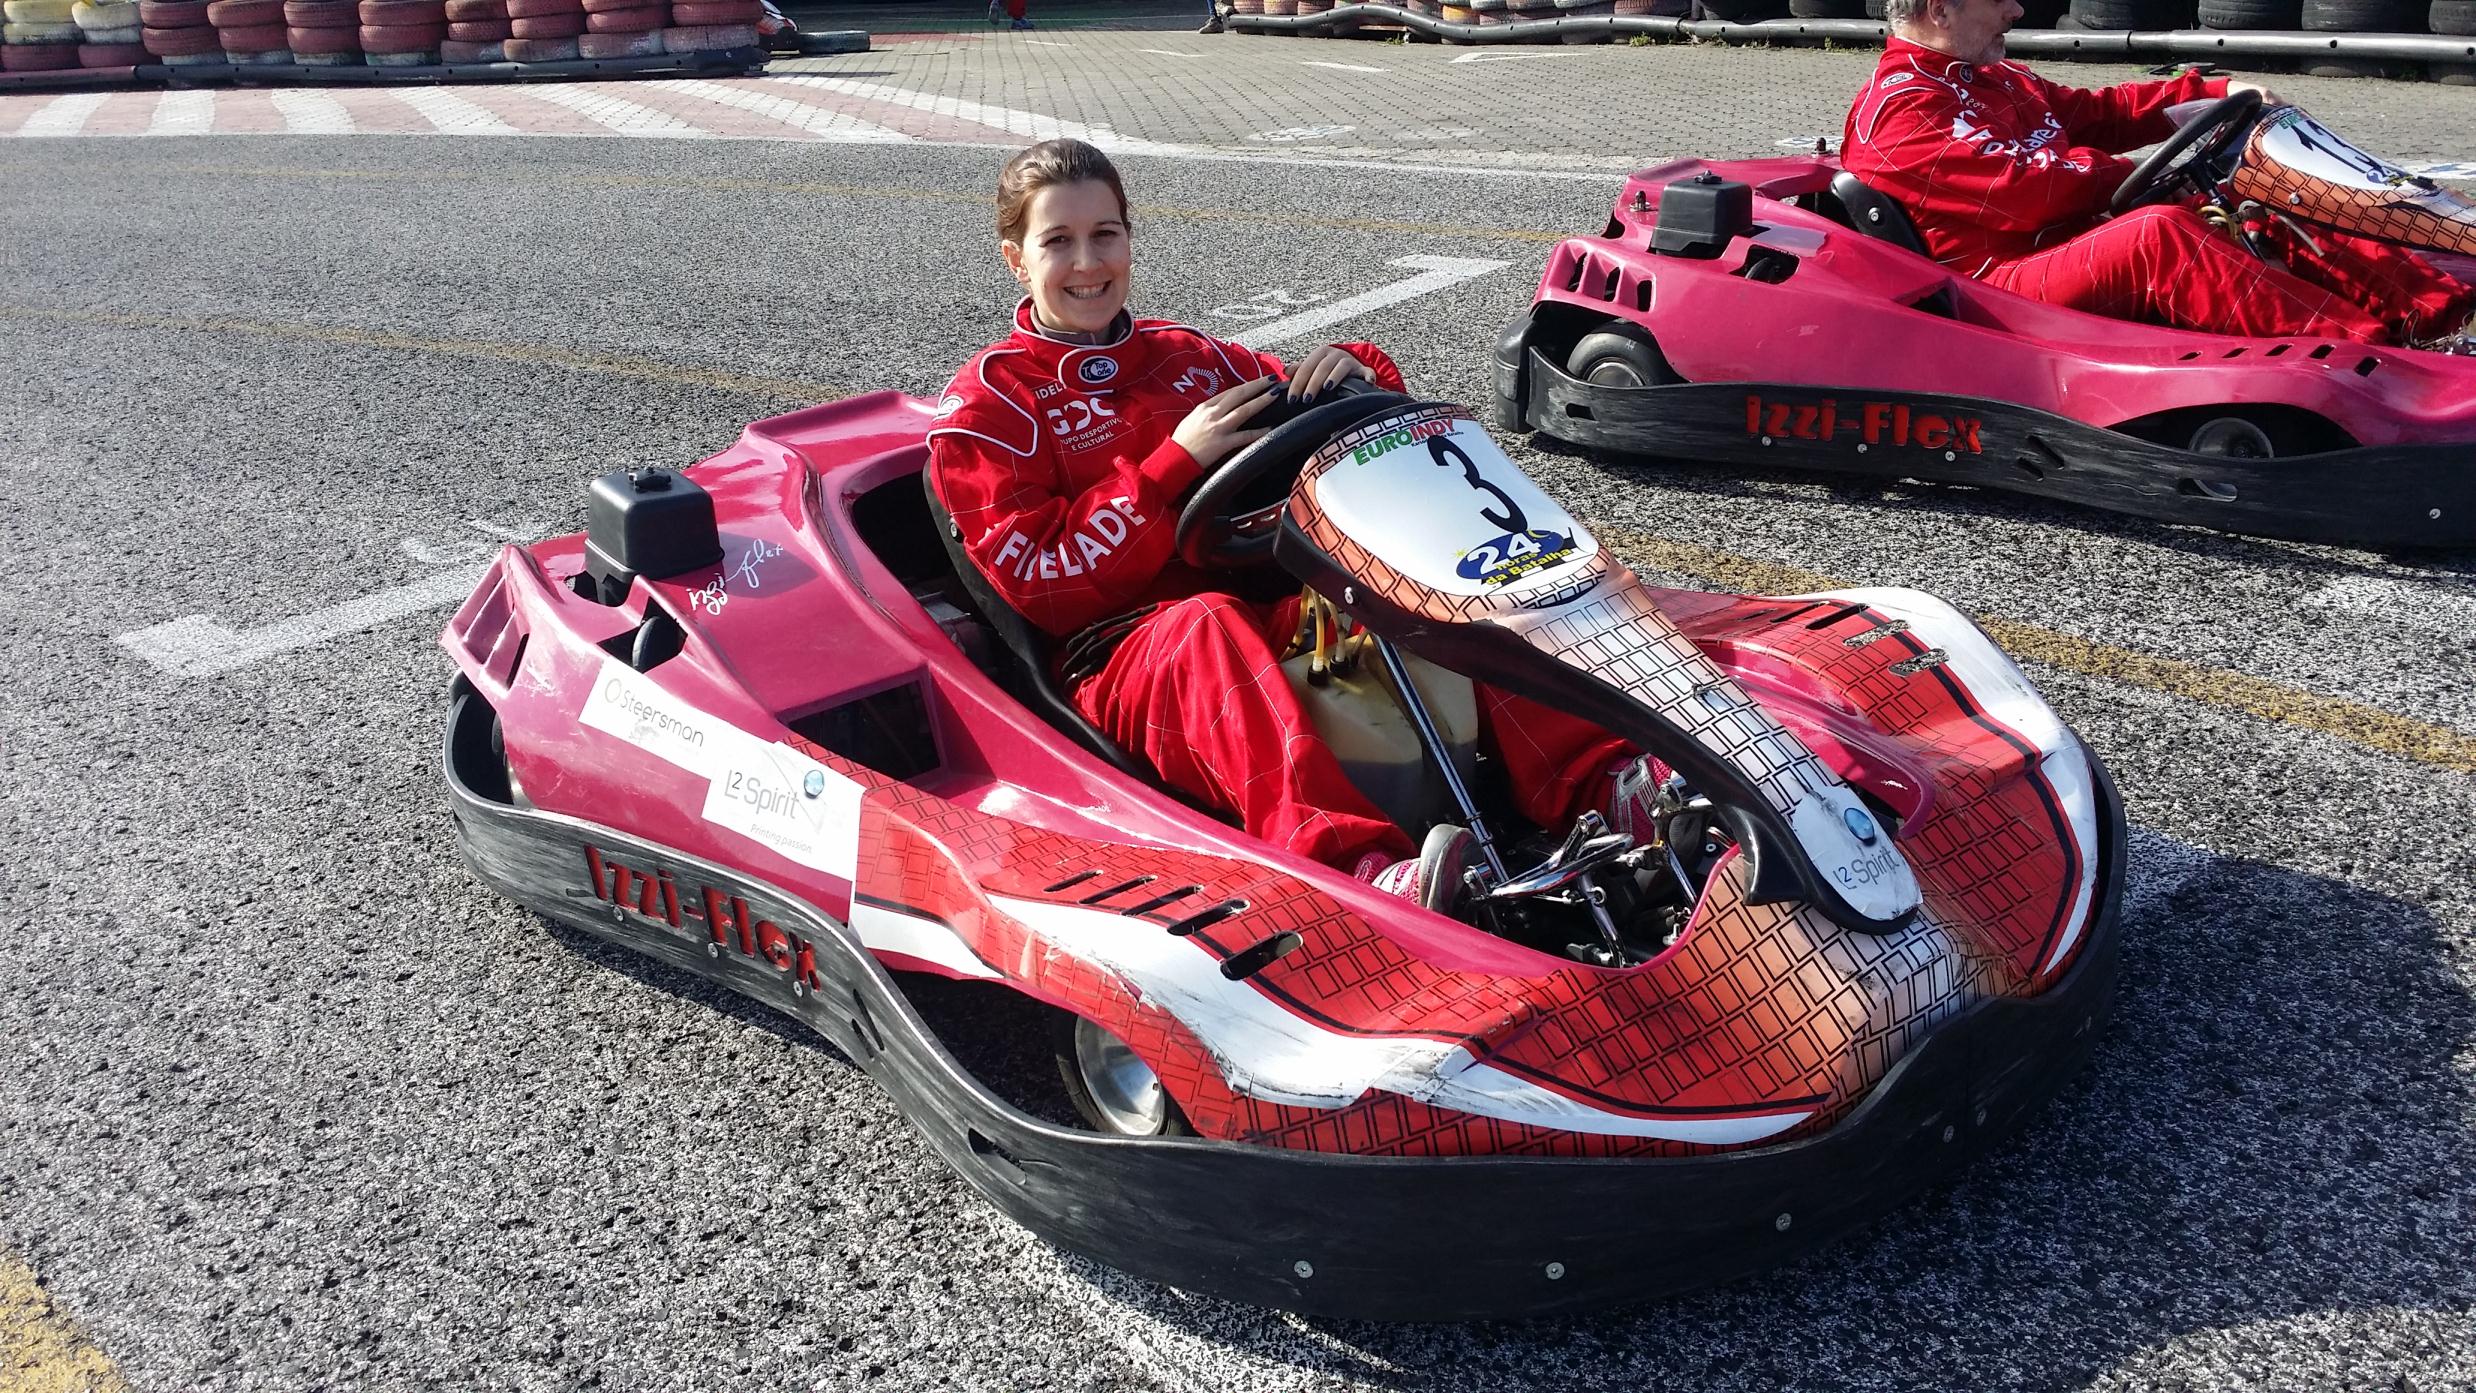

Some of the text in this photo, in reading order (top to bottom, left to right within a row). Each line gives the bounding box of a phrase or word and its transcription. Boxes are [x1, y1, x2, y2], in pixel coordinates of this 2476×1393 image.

[1077, 431, 1115, 449] CULTURAL
[1352, 416, 1456, 466] EUROINDY
[1746, 395, 1983, 455] Izzi-Flex
[1426, 435, 1528, 533] 3
[1467, 532, 1542, 575] 24
[1485, 548, 1573, 586] da Batalha
[620, 689, 704, 748] Steersman
[743, 776, 800, 820] Spirit
[1851, 845, 1900, 885] Spirit
[584, 843, 822, 993] Izzi-Flex
